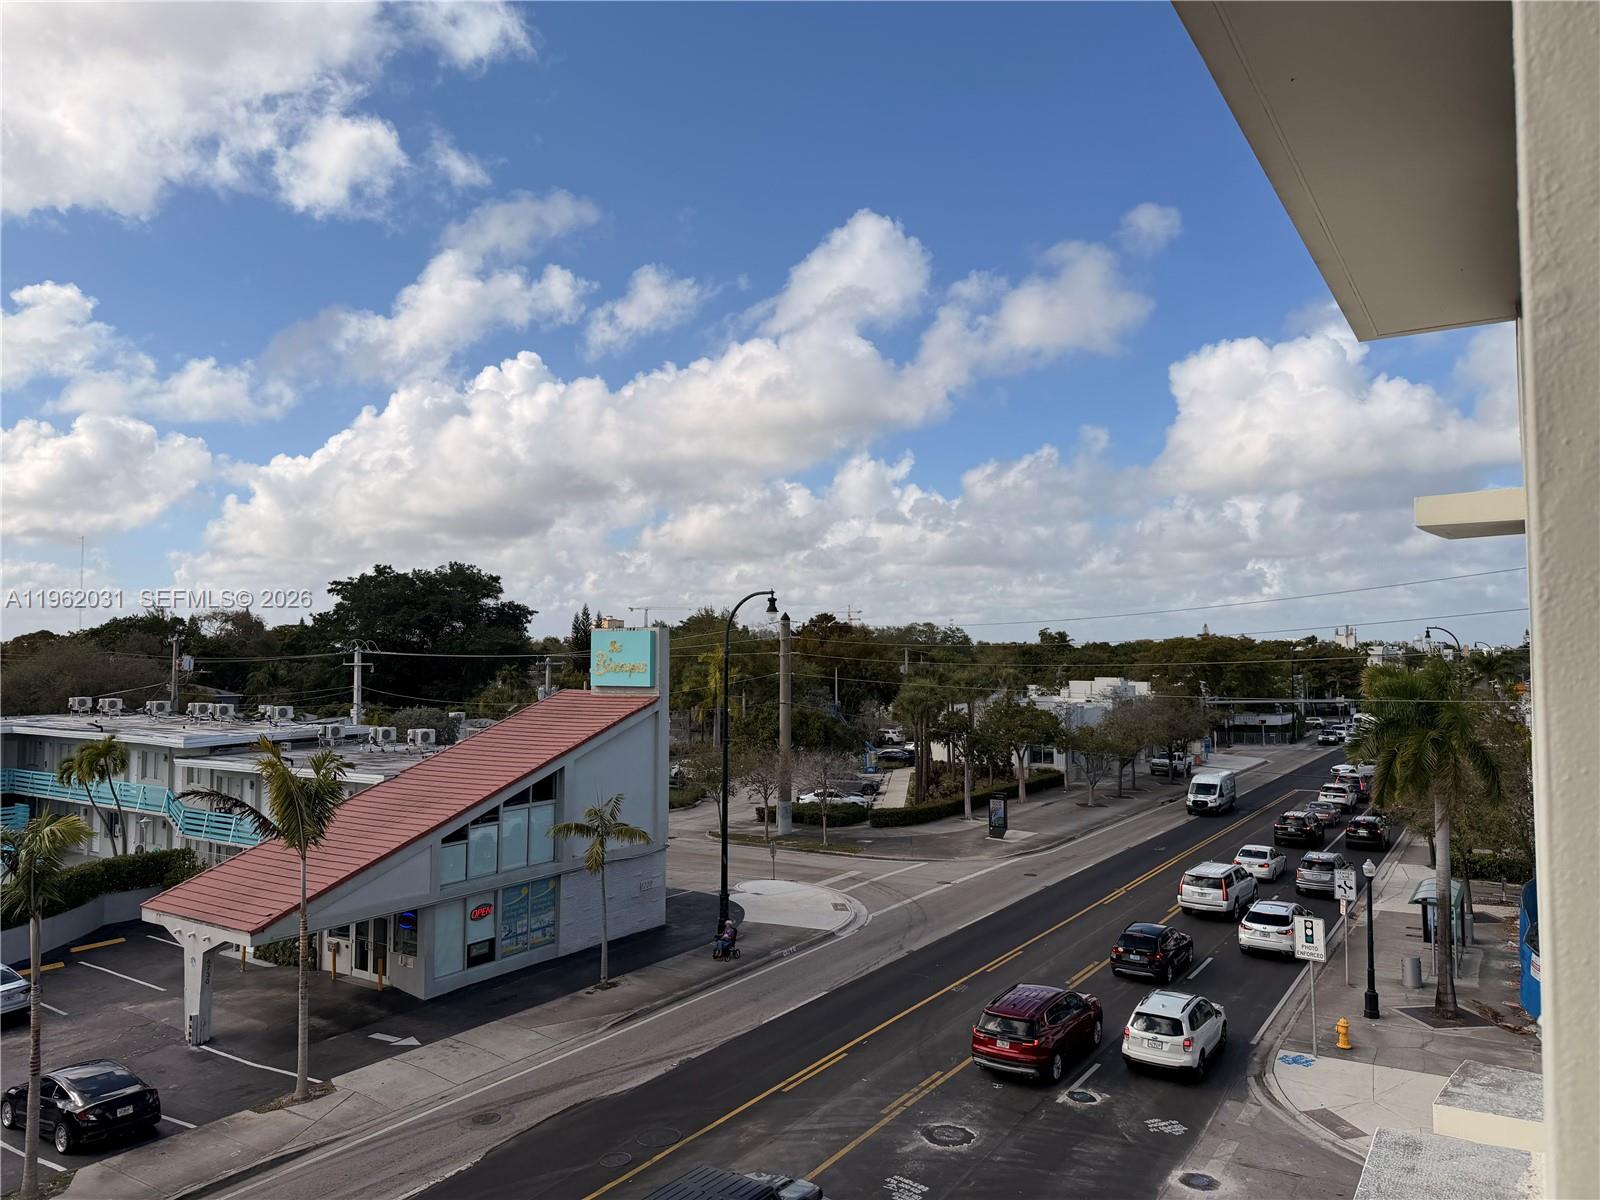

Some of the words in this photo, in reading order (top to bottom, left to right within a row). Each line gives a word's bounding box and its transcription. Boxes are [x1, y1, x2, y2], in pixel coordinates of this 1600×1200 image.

[471, 906, 493, 919] OPEN
[1301, 943, 1319, 952] PHOTO
[1296, 949, 1324, 959] ENFORCED
